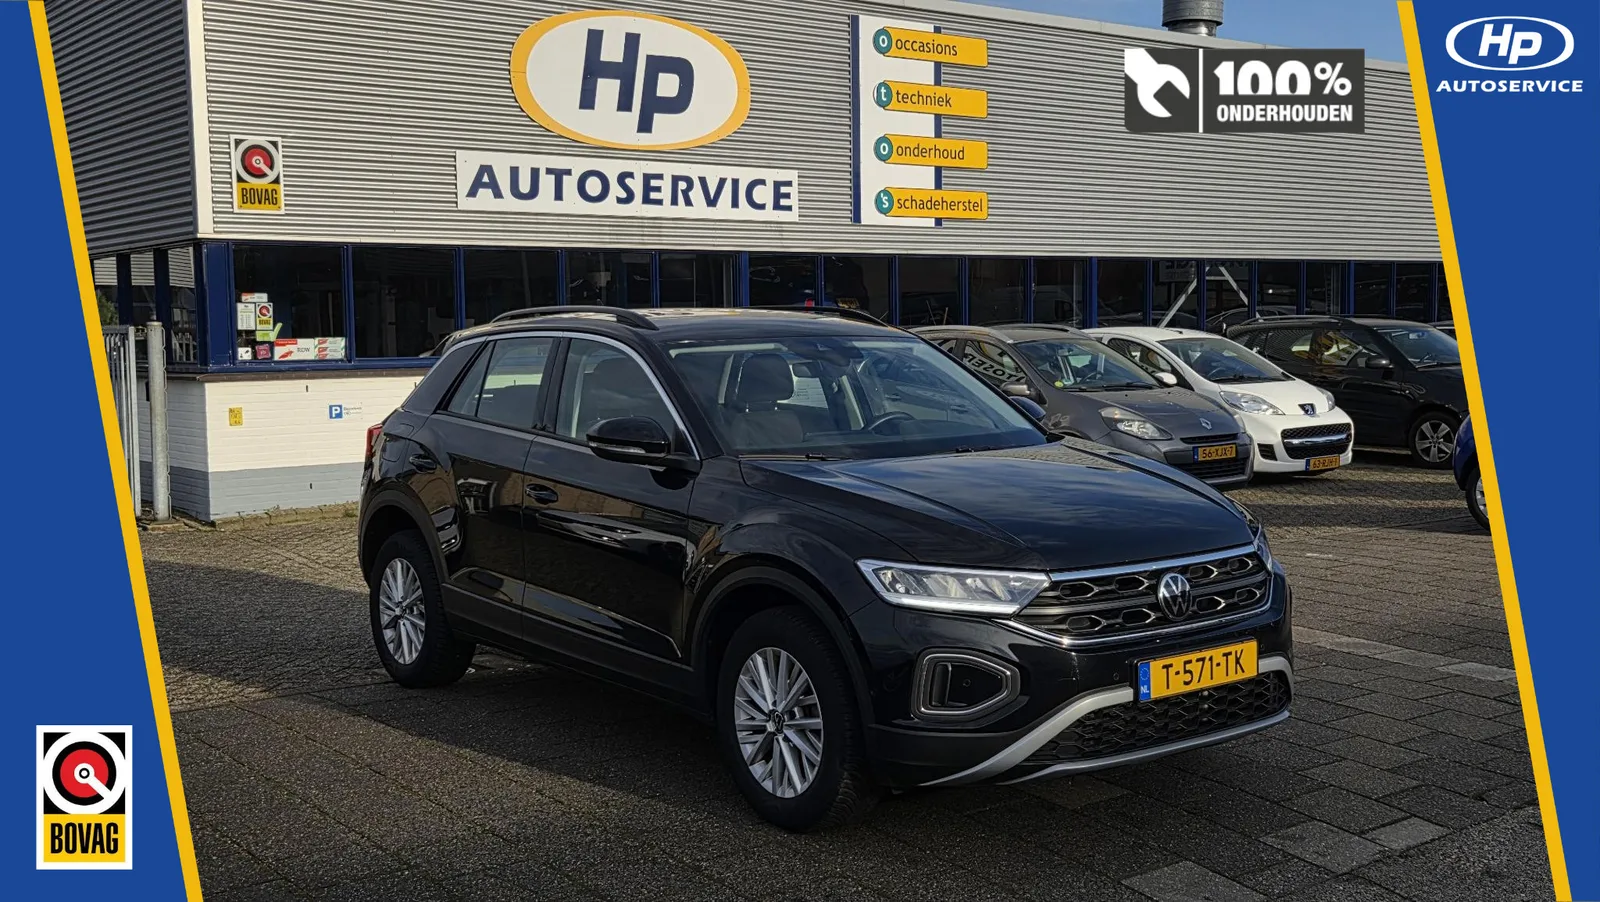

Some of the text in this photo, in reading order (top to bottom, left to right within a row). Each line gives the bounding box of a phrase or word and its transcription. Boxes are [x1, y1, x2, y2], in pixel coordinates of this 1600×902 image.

[895, 38, 958, 56] occasions
[896, 90, 952, 108] techniek
[896, 143, 965, 160] onderhoud
[241, 187, 278, 206] BOVAG
[465, 164, 793, 212] AUTOSERVICE
[897, 195, 983, 212] schadeherstel
[1140, 649, 1246, 693] NL T-571-TK
